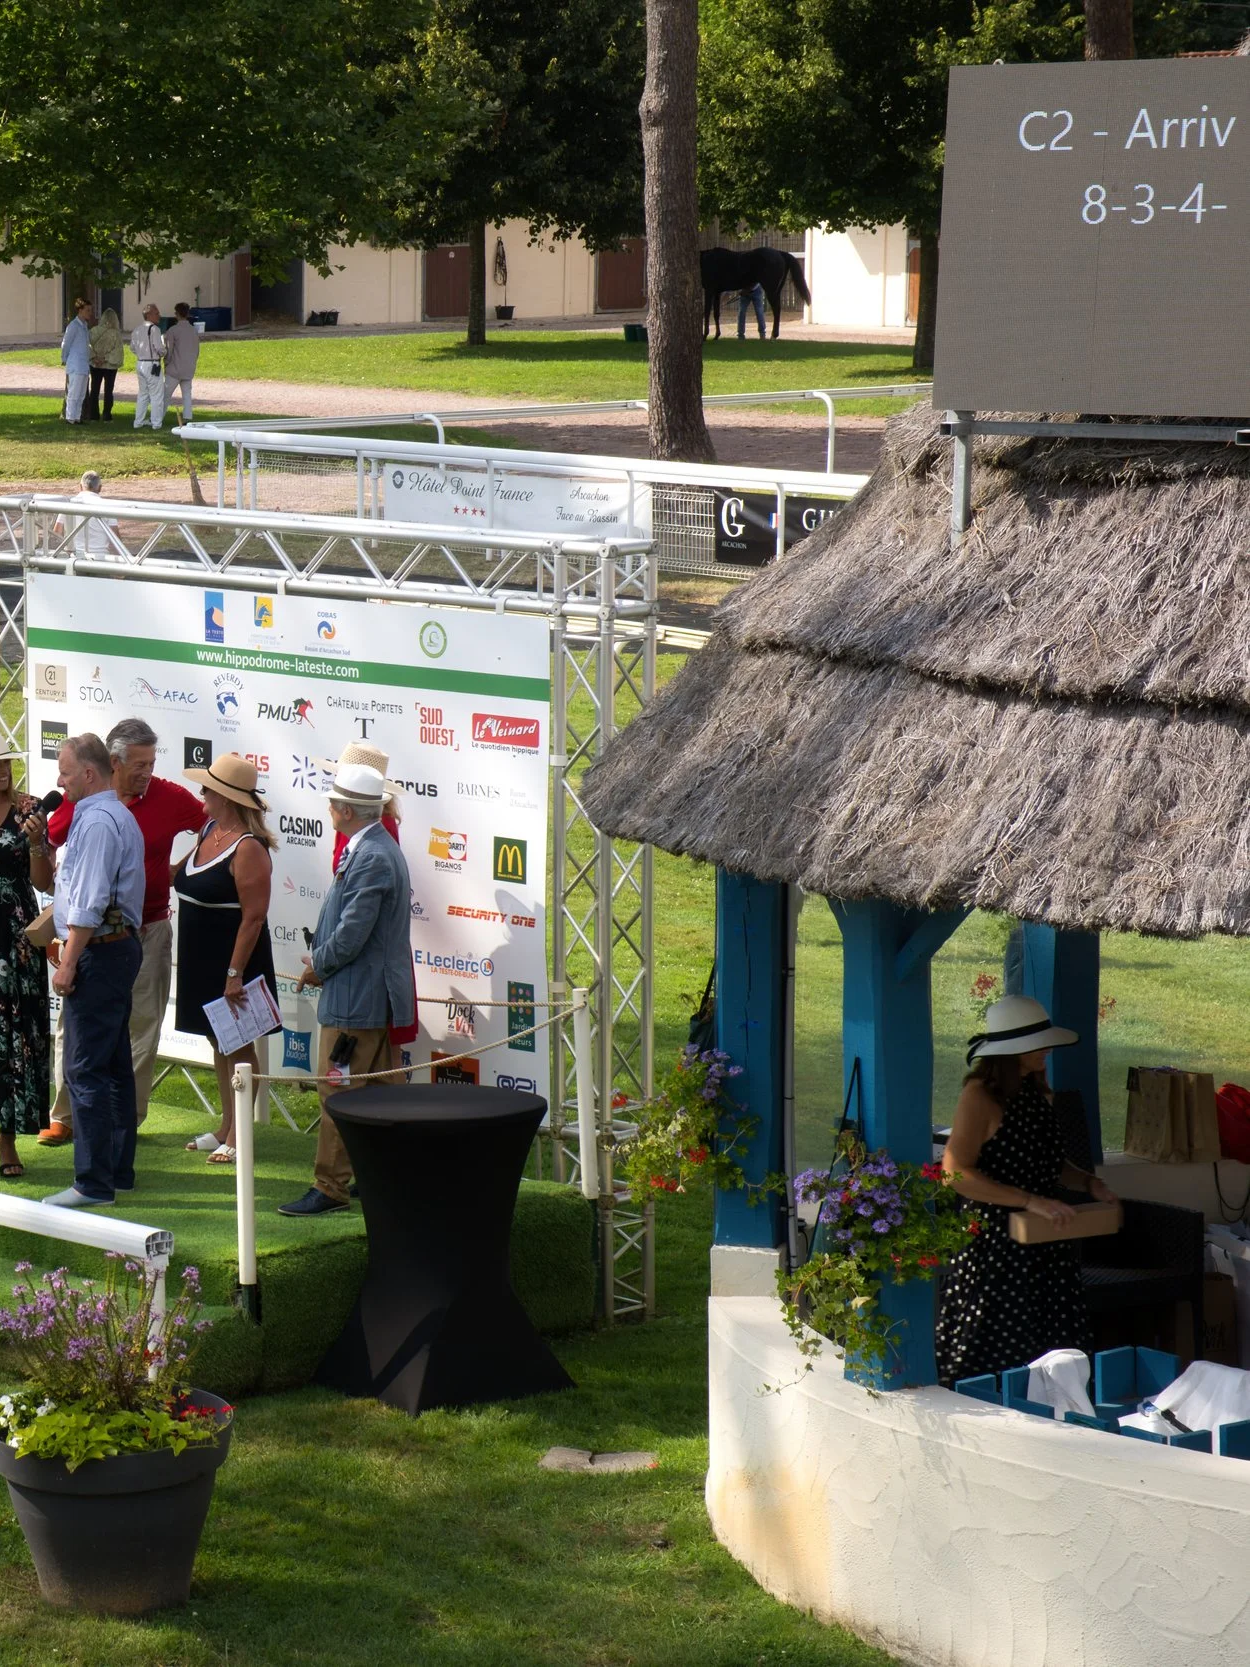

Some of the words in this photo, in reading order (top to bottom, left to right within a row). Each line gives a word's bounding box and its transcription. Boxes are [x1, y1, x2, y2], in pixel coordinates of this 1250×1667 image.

[1018, 110, 1074, 151] C2
[1124, 104, 1237, 150] Arriv
[1081, 182, 1228, 225] 8-3-4-
[409, 471, 448, 494] Hôtel
[450, 476, 486, 498] Point
[493, 479, 534, 502] France
[570, 486, 610, 502] Arcachon
[555, 506, 573, 522] Face
[574, 514, 584, 522] au
[587, 508, 618, 524] Bassin
[317, 611, 337, 619] COBAS
[196, 650, 360, 679] www.hippodrome-lateste.com
[213, 672, 245, 691] REVERDY
[35, 688, 61, 696] CENTURY
[79, 685, 114, 704] STOA
[163, 690, 199, 704] AFAC
[257, 702, 293, 722] PMU
[419, 706, 443, 726] SUD
[354, 717, 375, 739] T
[419, 726, 455, 747] OUEST
[474, 720, 485, 739] Le
[491, 719, 537, 737] Veinard
[480, 742, 510, 752] quotidien
[511, 746, 539, 756] hippique
[457, 781, 501, 799] BARNES
[279, 815, 323, 838] CASINO
[286, 836, 317, 848] ARCACHON
[434, 860, 462, 871] BIGANOS
[299, 886, 321, 899] Bleu
[446, 905, 508, 923] SECURITY
[511, 915, 536, 928] ONE
[274, 925, 298, 942] Clef
[414, 950, 479, 973] E.Leclerc
[445, 998, 475, 1023] Dock
[455, 1016, 474, 1034] Vin
[288, 1037, 305, 1052] ibis
